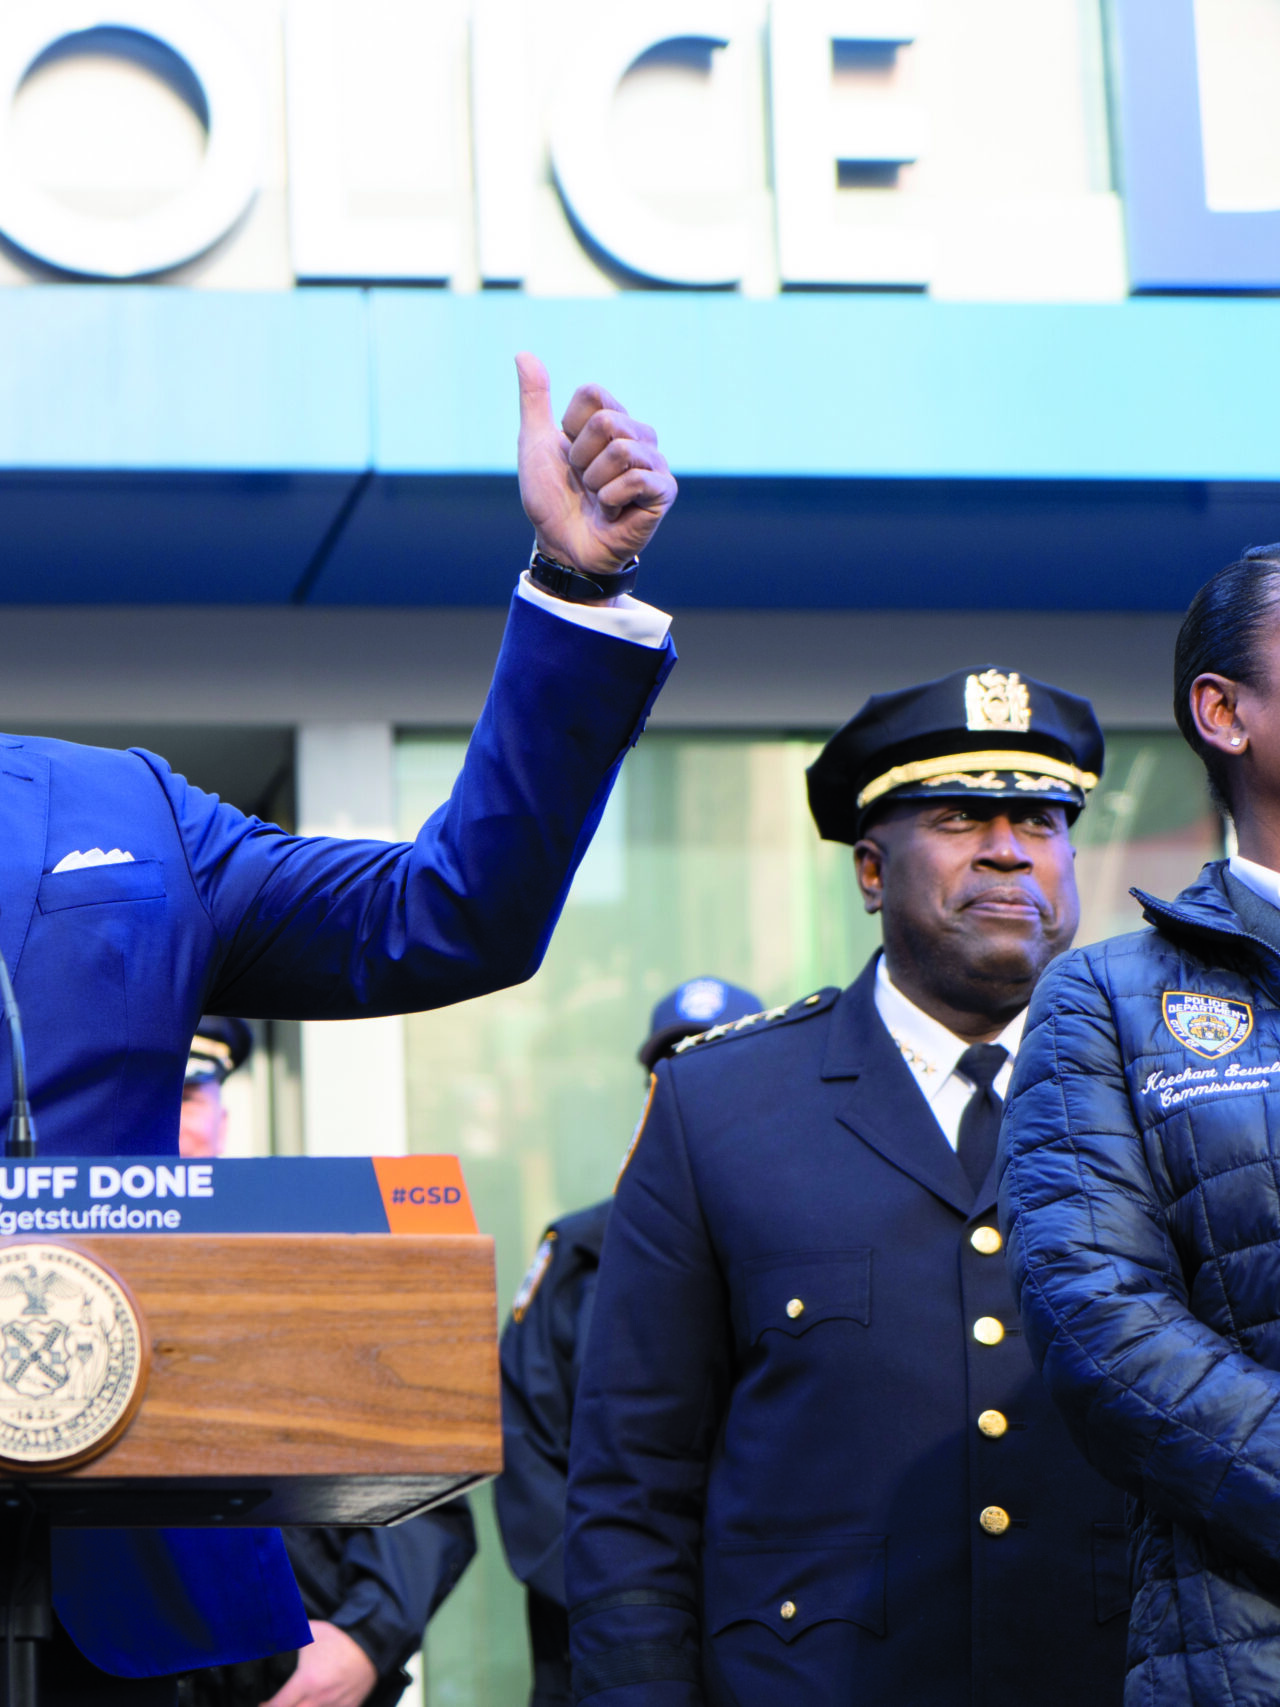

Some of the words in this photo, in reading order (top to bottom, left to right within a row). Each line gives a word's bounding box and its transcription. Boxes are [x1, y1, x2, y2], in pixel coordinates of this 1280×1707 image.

[1184, 996, 1229, 1008] POLICE
[1168, 1003, 1247, 1021] DEPARTMENT
[1170, 1019, 1189, 1037] CITY
[1232, 1023, 1249, 1039] YORK
[1224, 1061, 1280, 1077] Sewel
[1160, 1080, 1270, 1107] Commissioner
[89, 1165, 214, 1199] DONE
[392, 1186, 461, 1205] #GSD
